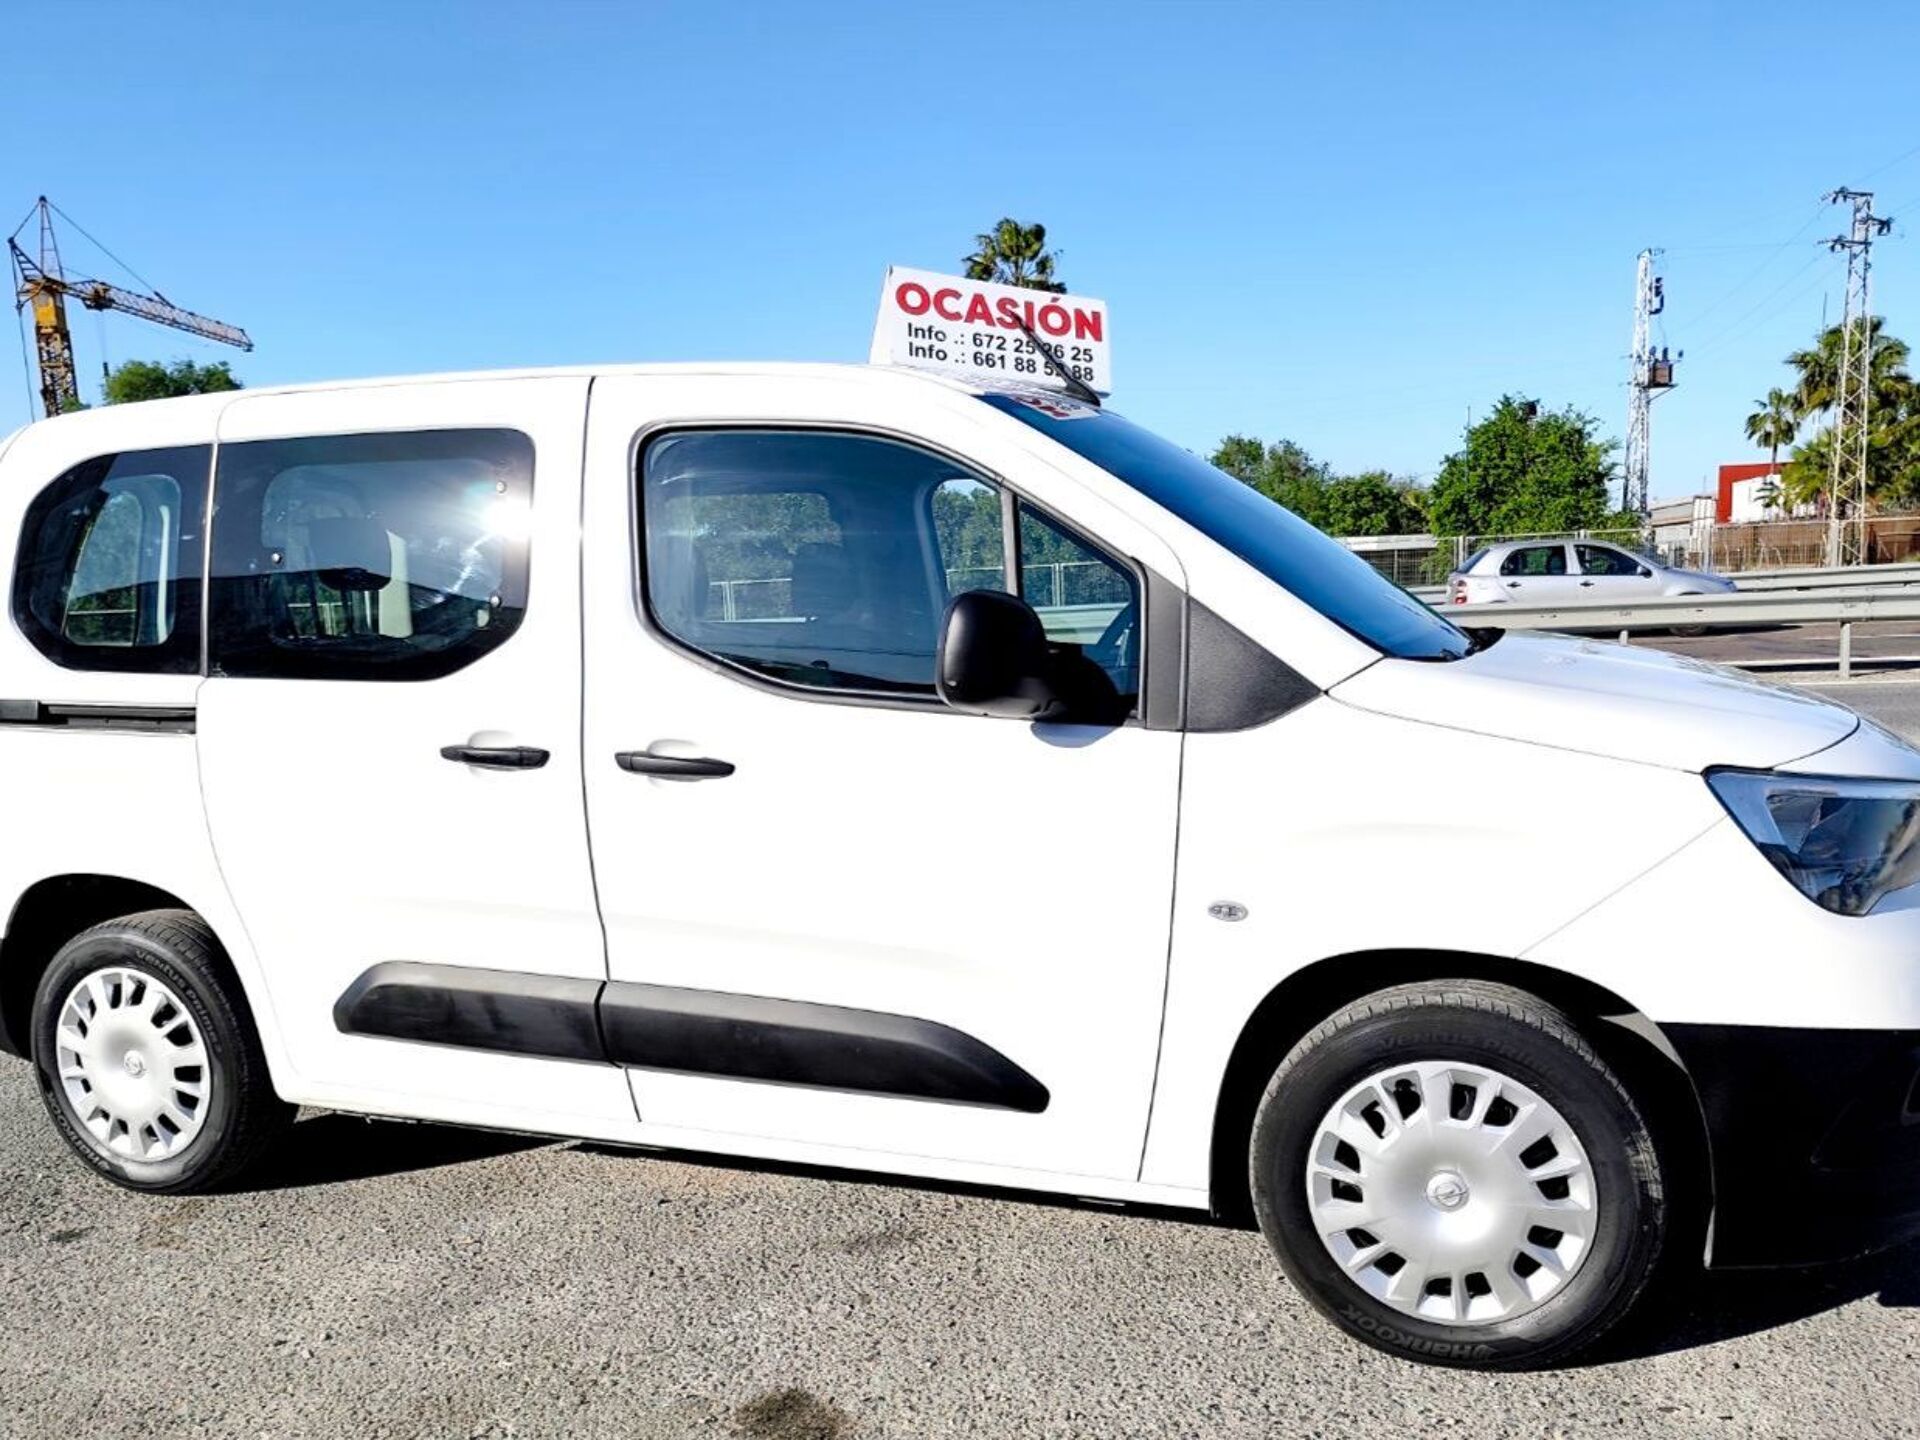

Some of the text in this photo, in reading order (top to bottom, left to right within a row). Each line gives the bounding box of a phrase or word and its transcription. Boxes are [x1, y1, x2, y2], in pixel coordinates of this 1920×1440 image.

[896, 282, 1103, 342] OCASIÓN
[908, 322, 947, 342] Info
[972, 333, 1006, 351] 672
[1014, 338, 1035, 355] 25
[1071, 346, 1093, 363] 25
[909, 342, 947, 361] Info
[973, 352, 1006, 369] 661
[1014, 357, 1037, 373] 88
[1044, 361, 1064, 377] 5
[1072, 365, 1094, 381] 88
